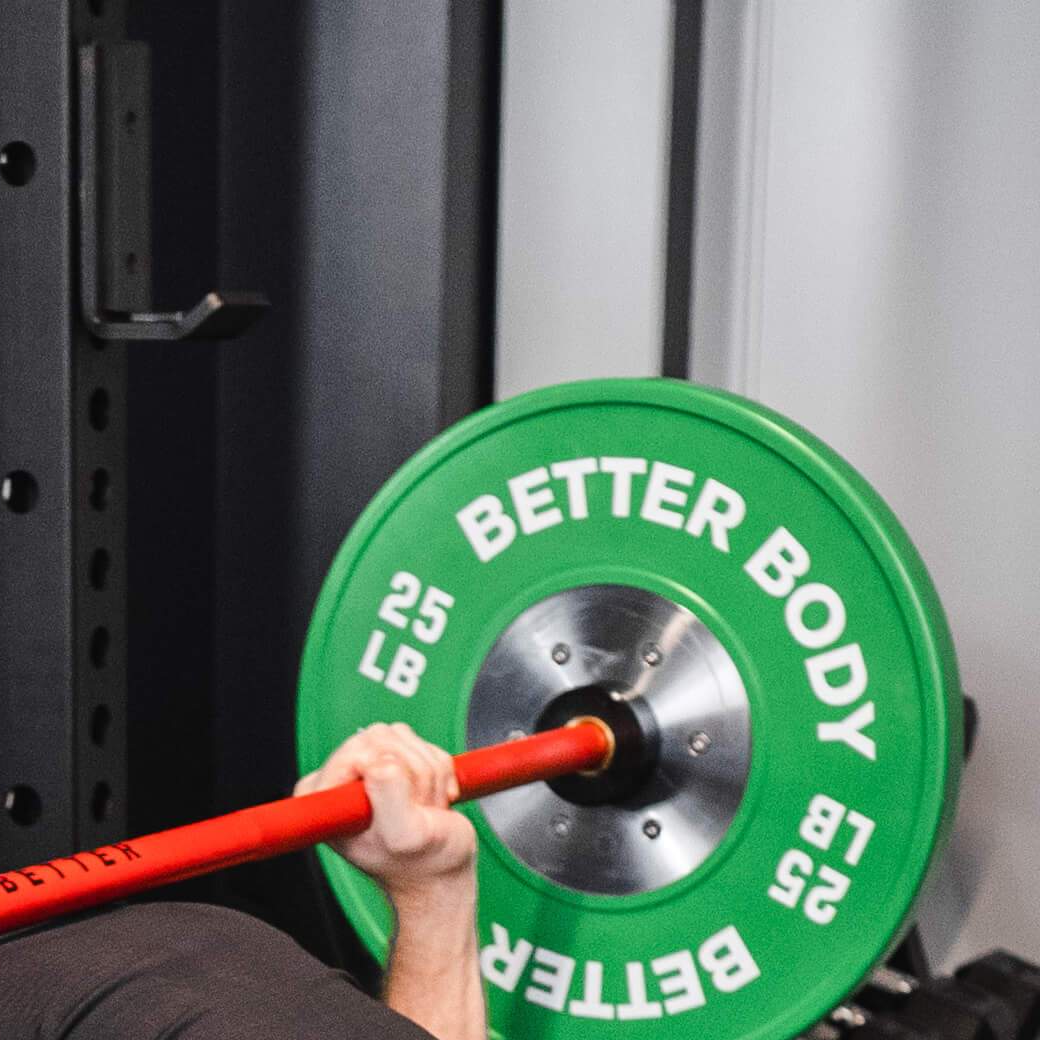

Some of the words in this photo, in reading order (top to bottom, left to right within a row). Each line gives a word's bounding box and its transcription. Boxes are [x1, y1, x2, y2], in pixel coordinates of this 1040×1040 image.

[378, 570, 455, 645] 25
[454, 455, 747, 564] BETTER
[743, 525, 877, 761] BODY
[357, 629, 427, 699] LB
[798, 793, 876, 866] LB
[767, 848, 852, 926] 25
[479, 921, 762, 1021] BETTER
